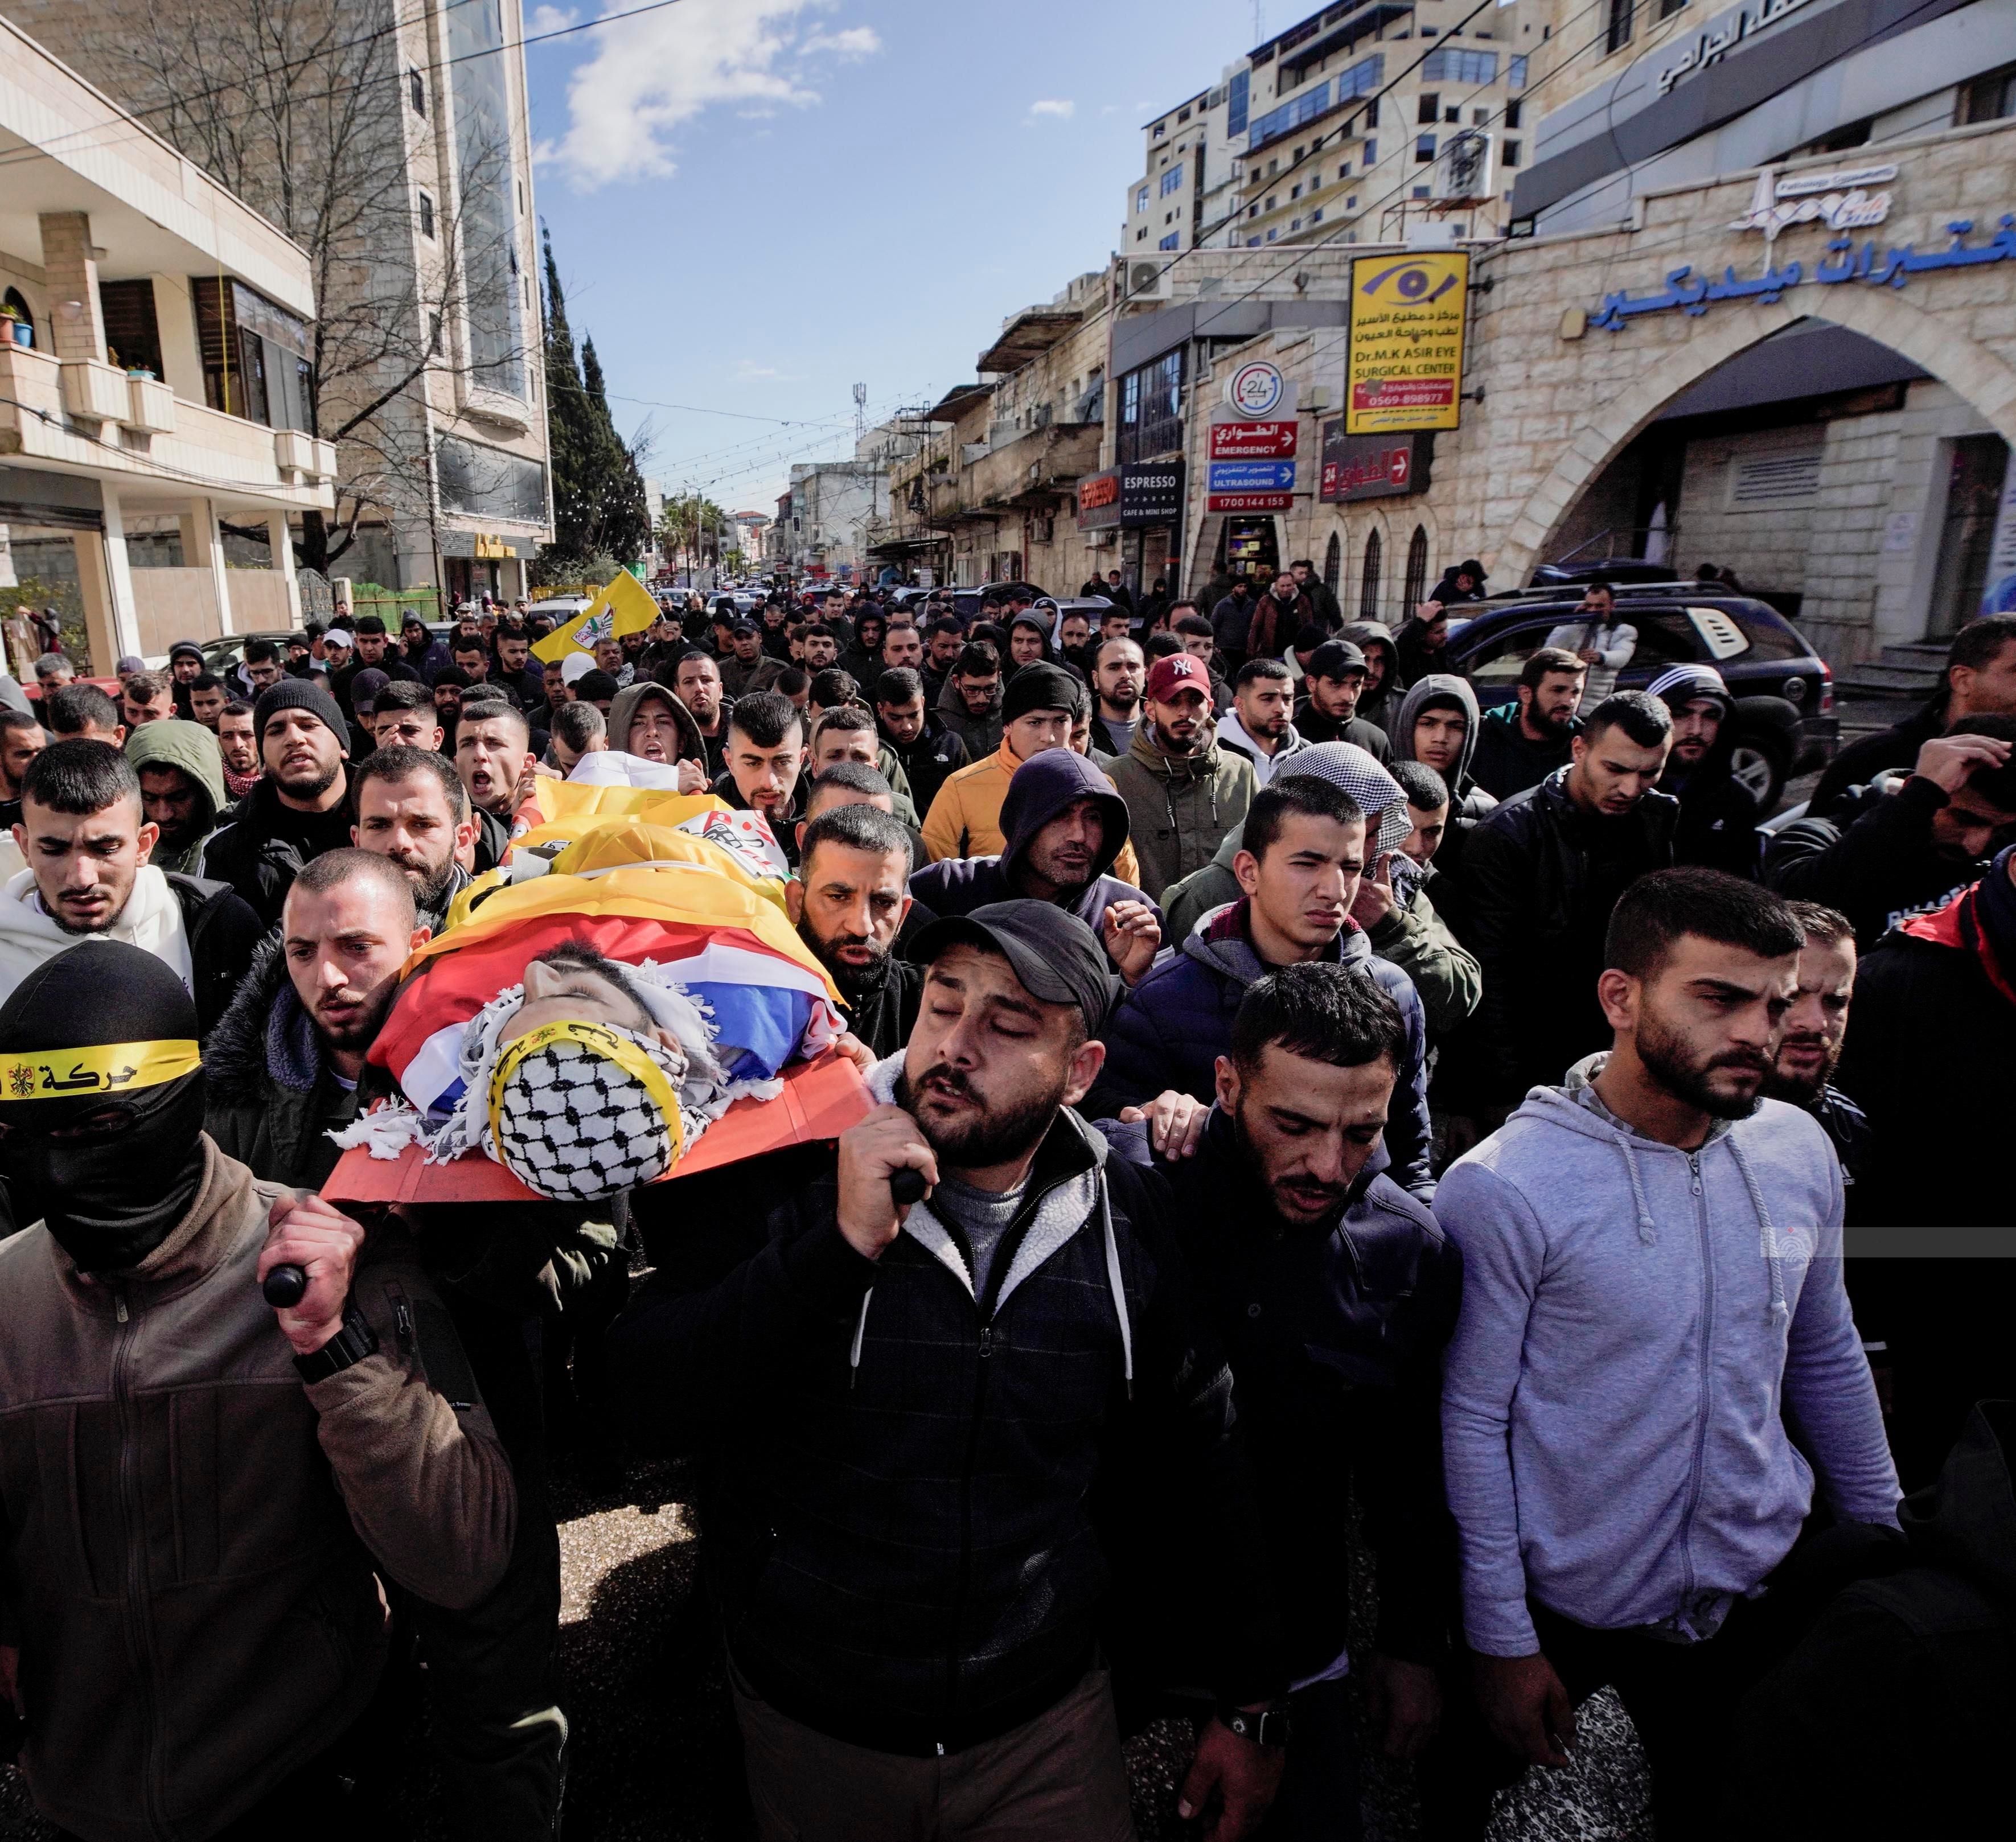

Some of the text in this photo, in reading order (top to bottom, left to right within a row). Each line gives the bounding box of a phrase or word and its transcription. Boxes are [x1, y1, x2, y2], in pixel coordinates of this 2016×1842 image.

[1393, 311, 1425, 323] مطيع
[1436, 310, 1460, 320] مركز
[1355, 329, 1393, 342] العيون
[1436, 326, 1458, 336] لطب
[1403, 347, 1433, 359] ASIR
[1436, 346, 1457, 357] EYE
[1355, 363, 1455, 379] SURGICAL CENTER
[1215, 445, 1276, 455] EMERGENCY
[1248, 465, 1275, 474] التصوير
[1324, 467, 1336, 483] 24
[1124, 475, 1176, 489] ESPRESSO
[1214, 478, 1275, 487] ULTRASOUND
[1220, 497, 1284, 507] 1700 144 155
[1173, 659, 1193, 675] NY
[38, 1062, 138, 1091] حركة
